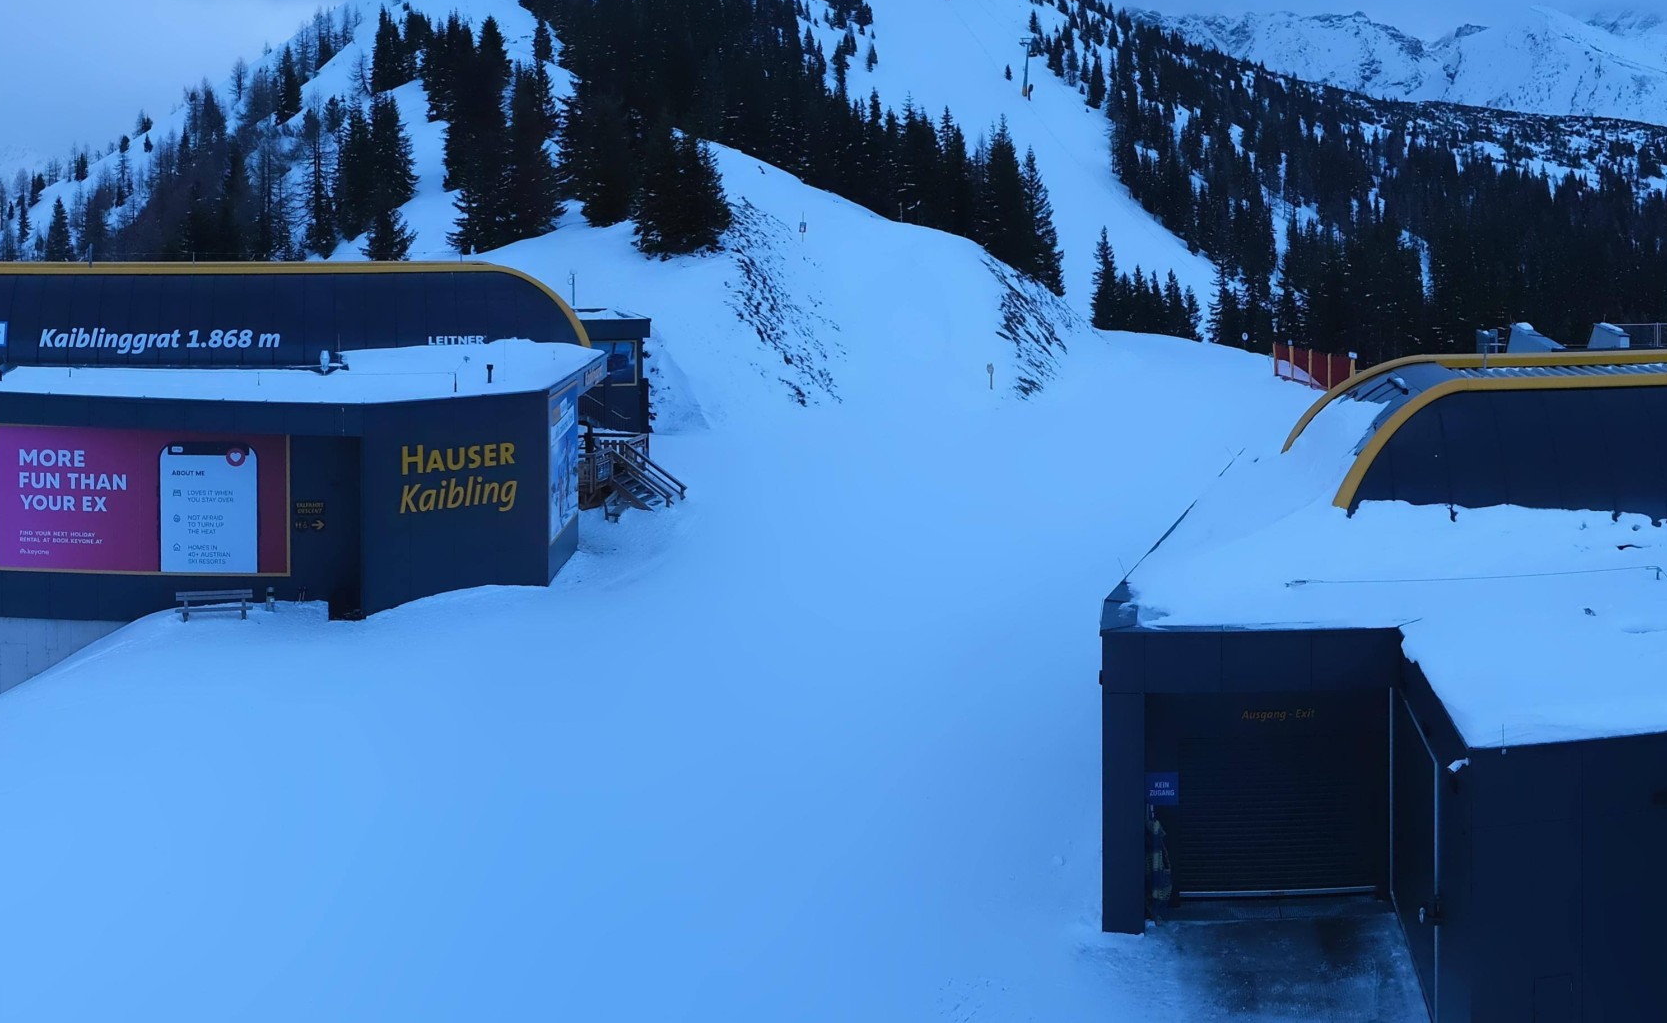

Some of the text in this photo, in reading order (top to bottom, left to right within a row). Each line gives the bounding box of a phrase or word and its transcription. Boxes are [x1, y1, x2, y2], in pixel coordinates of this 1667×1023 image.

[39, 327, 281, 355] Kaiblinggrat 1.868 m
[428, 335, 485, 346] LEITNER
[19, 448, 86, 468] MORE
[402, 442, 516, 475] HAUSER
[19, 471, 128, 491] FUN THAN
[20, 494, 108, 513] YOUR EX
[399, 475, 518, 515] Kaibling
[1241, 709, 1288, 722] Ausgang
[1295, 707, 1315, 719] Exit
[1149, 789, 1175, 797] ZUGANG
[1154, 781, 1170, 789] KEIN
